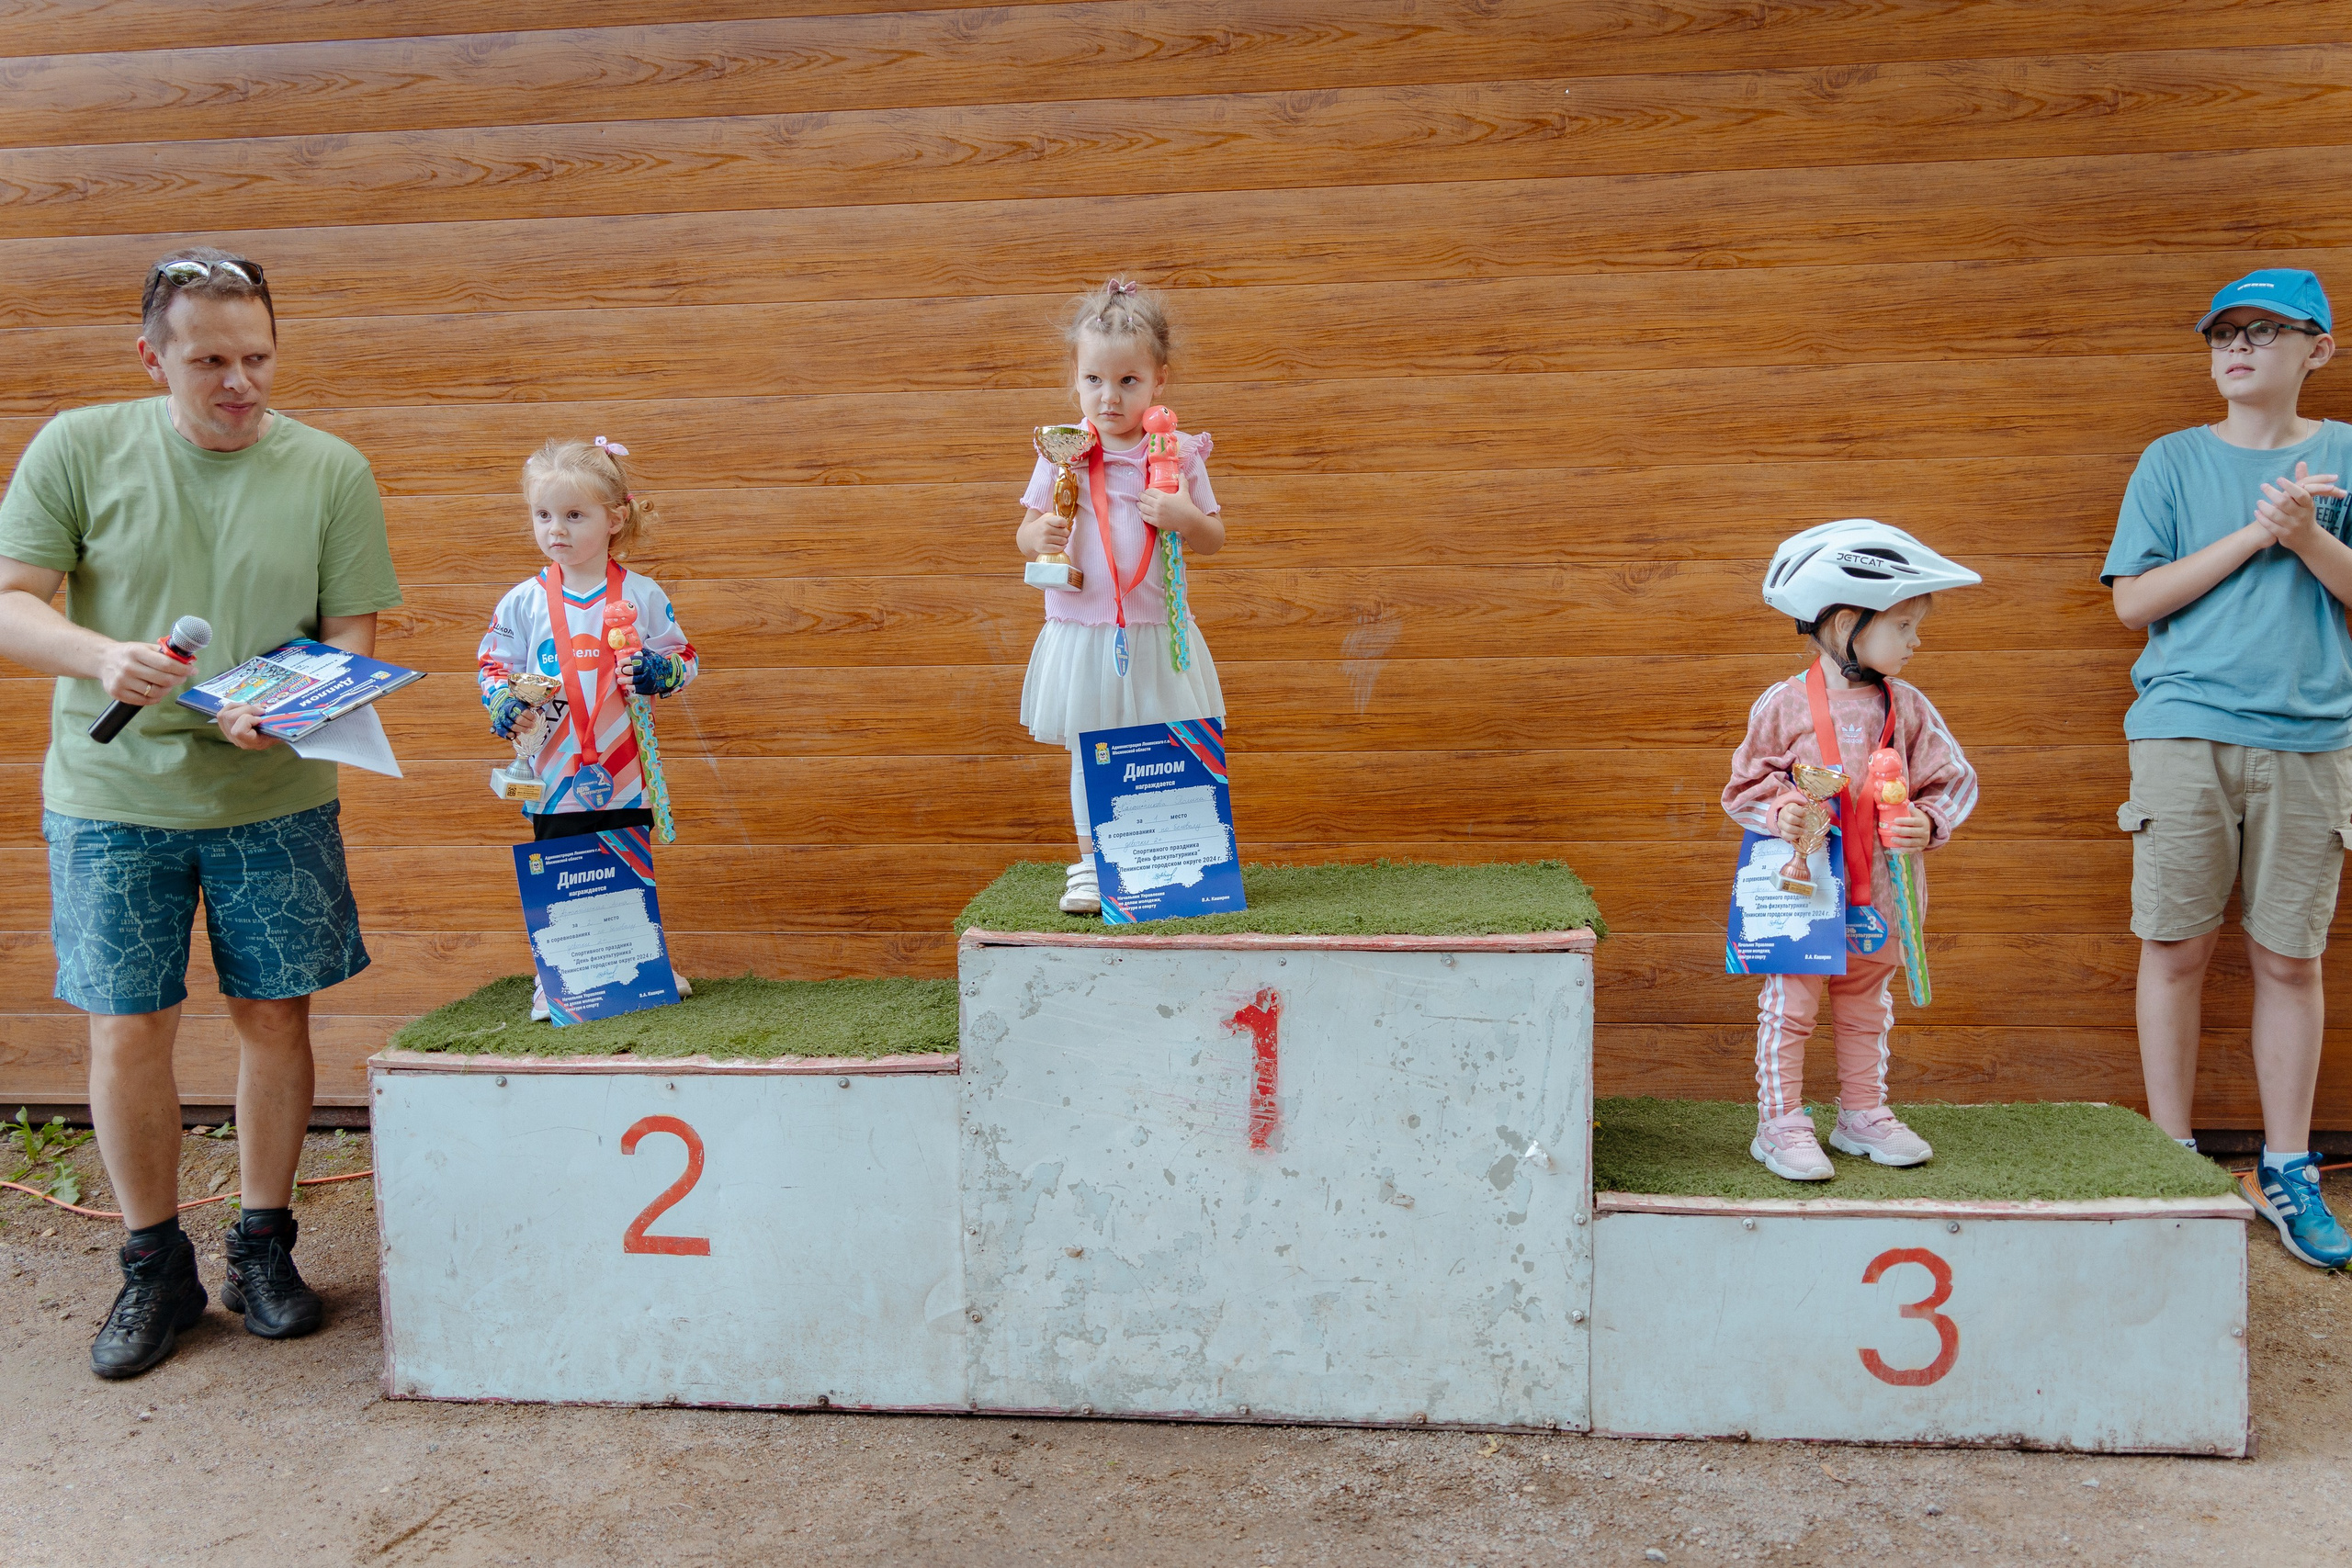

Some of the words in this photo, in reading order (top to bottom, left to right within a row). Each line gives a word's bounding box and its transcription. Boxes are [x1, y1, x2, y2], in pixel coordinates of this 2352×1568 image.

[2316, 507, 2341, 525] EEDS
[1836, 553, 1884, 568] JETCAT
[300, 677, 355, 707] Диплом
[597, 772, 605, 786] 2
[1123, 761, 1185, 783] Диплом
[1136, 781, 1176, 790] награждается
[1114, 828, 1156, 840] соревнованиях
[1132, 845, 1169, 856] Спортивного
[1170, 842, 1200, 851] праздника
[1119, 864, 1150, 873] Ленинском
[1152, 861, 1182, 871] городском
[1183, 858, 1202, 868] округе
[557, 867, 616, 890] Диплом
[569, 886, 606, 897] награждается
[1867, 915, 1877, 931] 3
[551, 931, 591, 943] соревнованиях
[571, 946, 605, 957] Спортивного
[605, 942, 632, 952] праздника
[590, 961, 617, 970] городском
[1227, 990, 1280, 1152] 1
[621, 1114, 709, 1256] 2
[1860, 1247, 1959, 1385] 3
